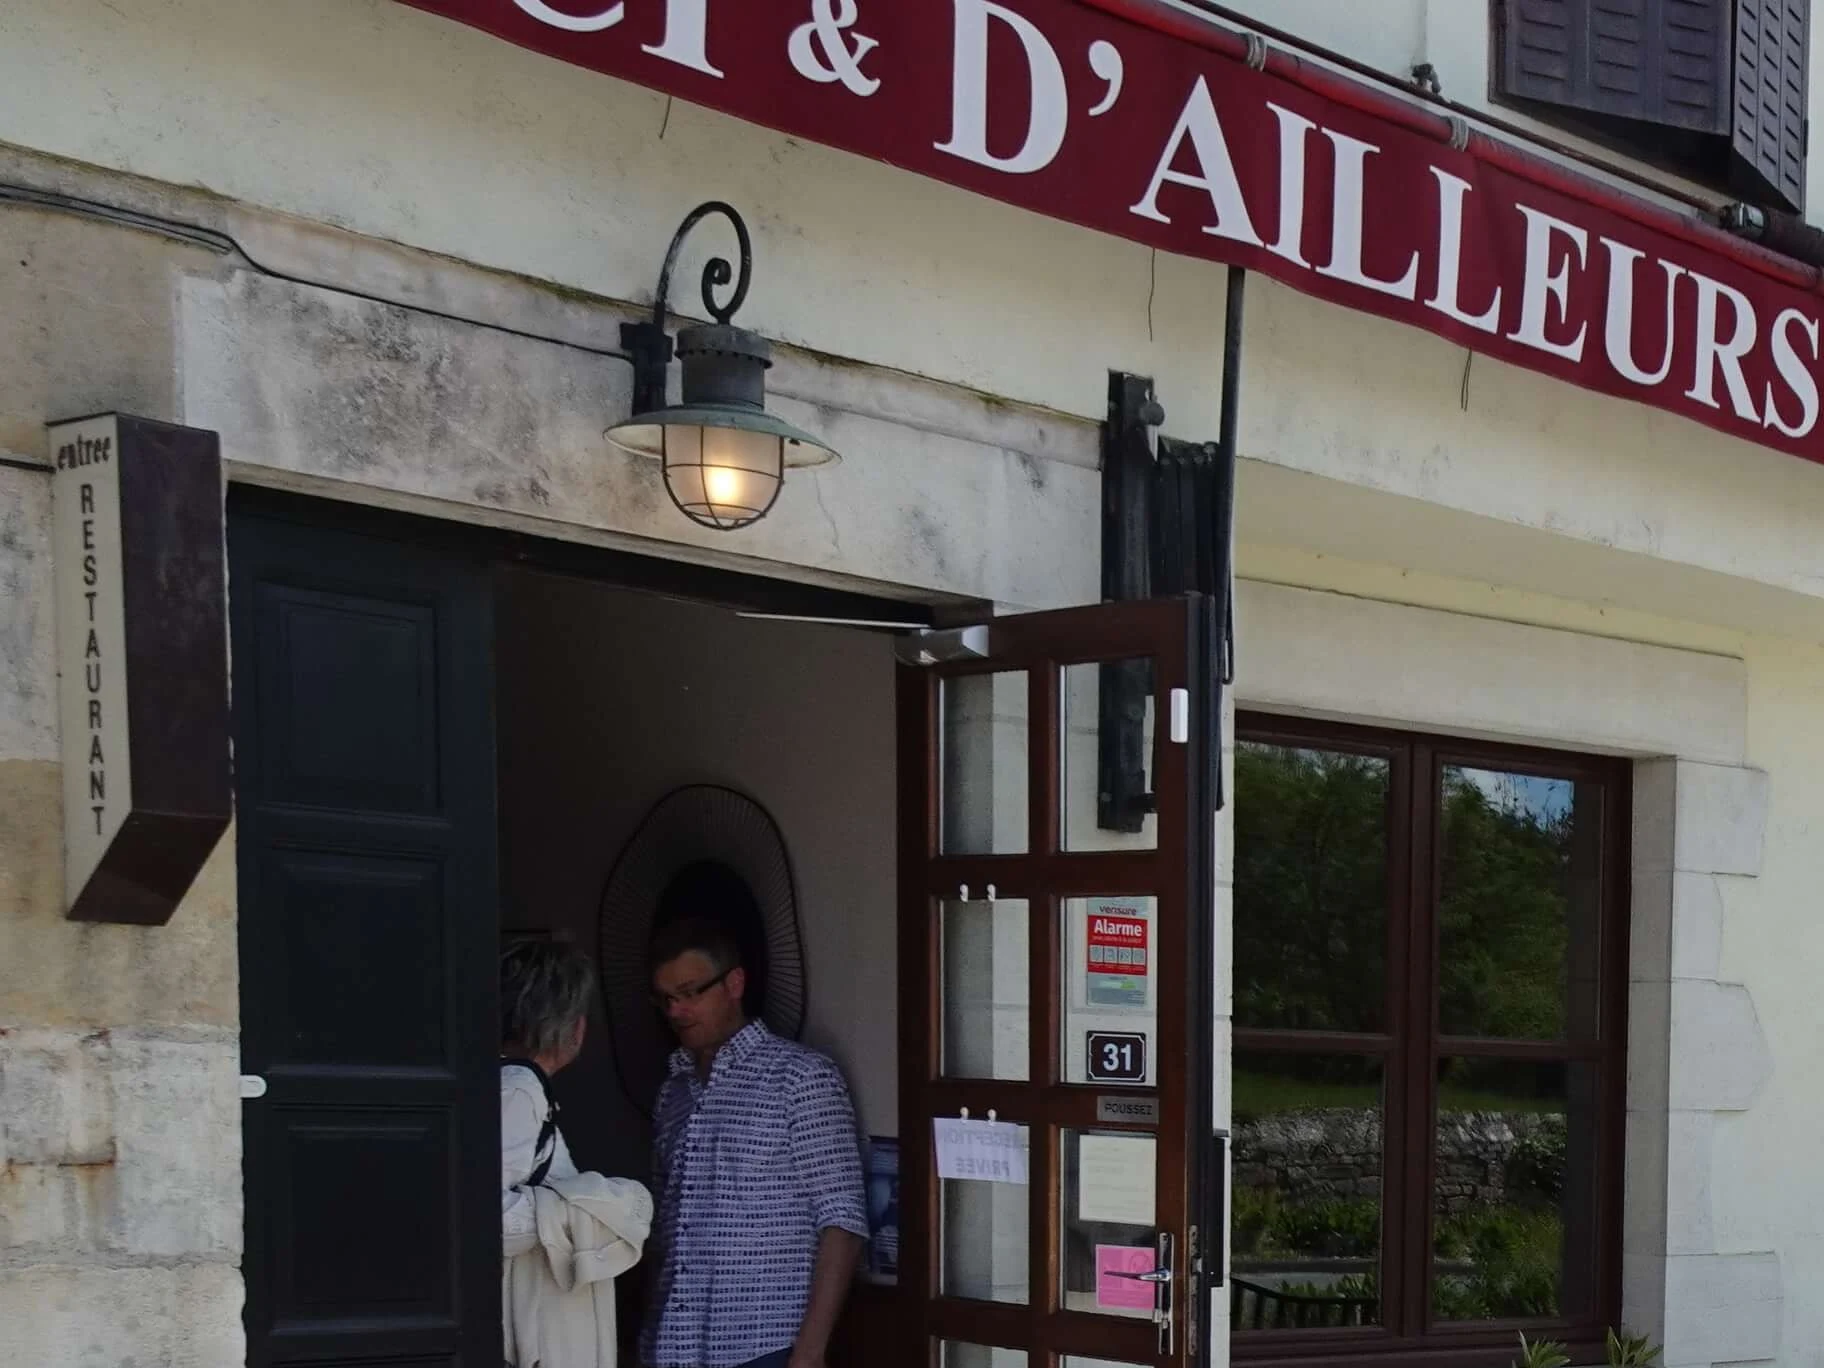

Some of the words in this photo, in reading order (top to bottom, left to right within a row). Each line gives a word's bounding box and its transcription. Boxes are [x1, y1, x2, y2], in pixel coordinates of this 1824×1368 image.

[788, 0, 881, 97] &
[932, 0, 1821, 438] D'AILLEURS
[80, 483, 106, 836] RESTAURANT
[1094, 918, 1143, 937] Alarme
[1103, 1043, 1132, 1072] 31
[1104, 1103, 1153, 1116] POUSSEZ
